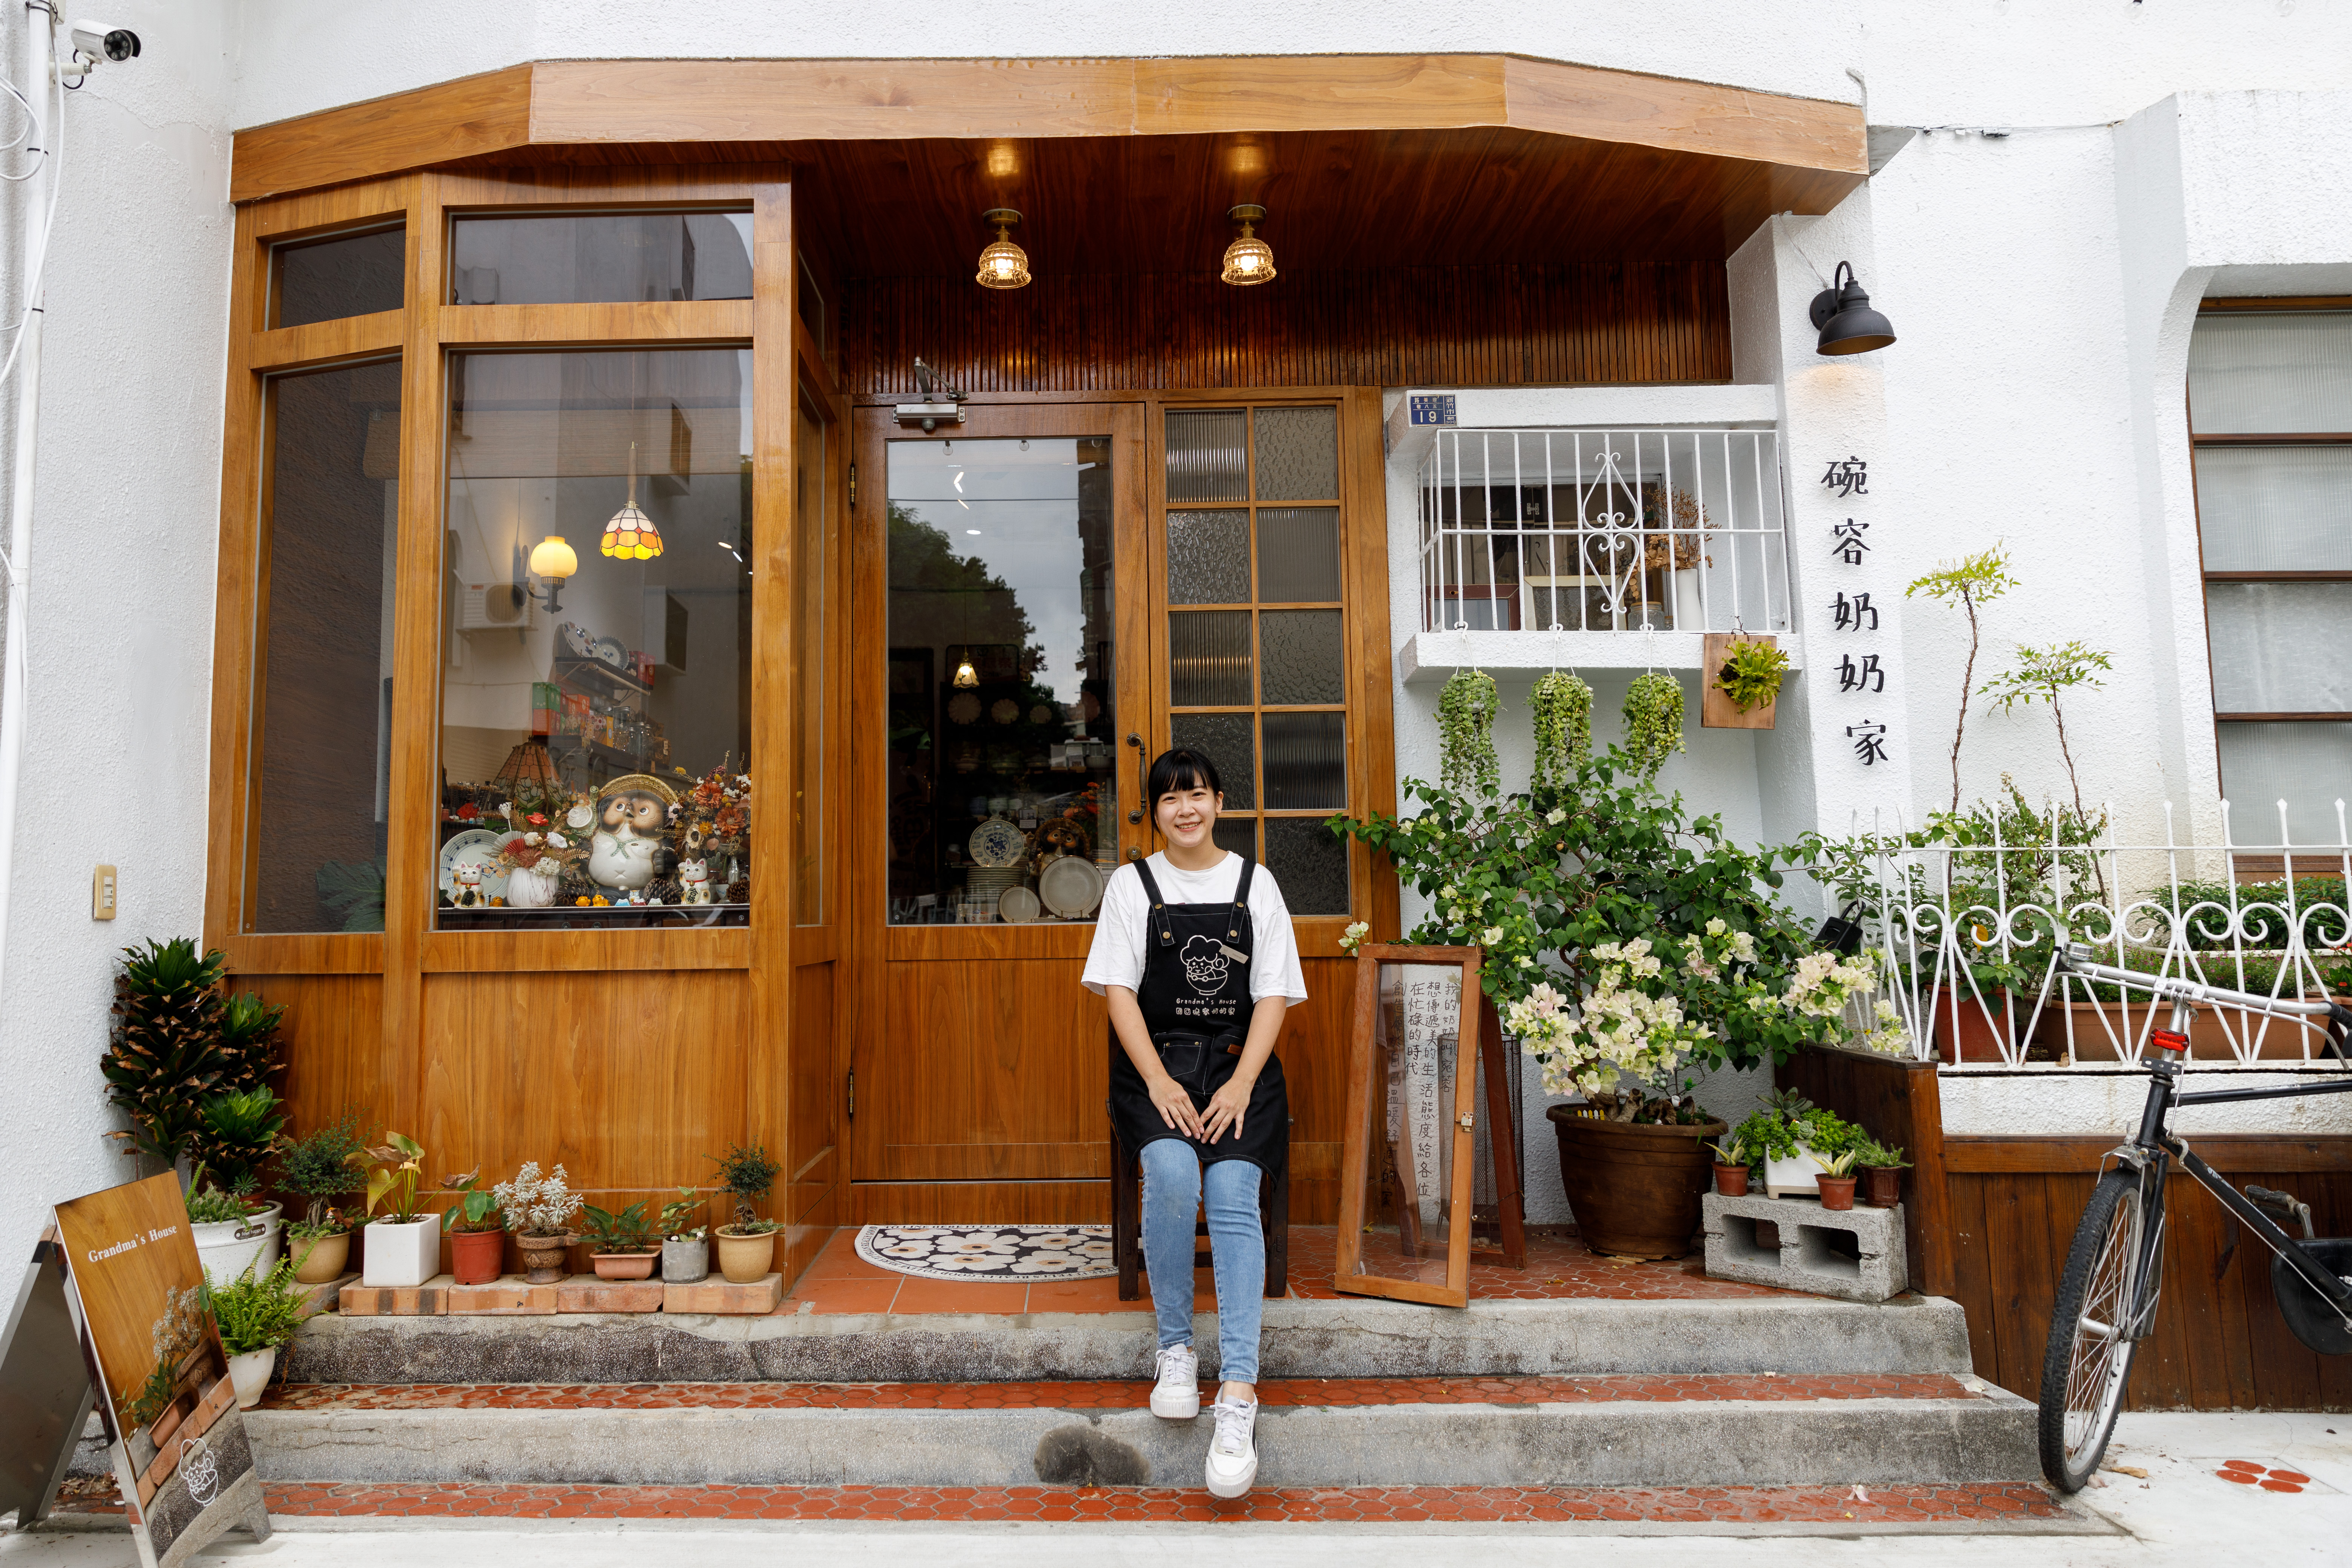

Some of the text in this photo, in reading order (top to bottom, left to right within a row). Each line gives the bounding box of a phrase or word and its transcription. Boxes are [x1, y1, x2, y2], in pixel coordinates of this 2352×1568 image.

[1446, 396, 1454, 415] 新竹市
[1420, 411, 1437, 423] 19
[1821, 455, 1888, 766] 碗容奶奶家
[462, 891, 475, 906] 合格
[687, 888, 698, 904] 合格
[1405, 982, 1425, 1075] 在忙碌的時代
[88, 1225, 178, 1262] Grandma's House
